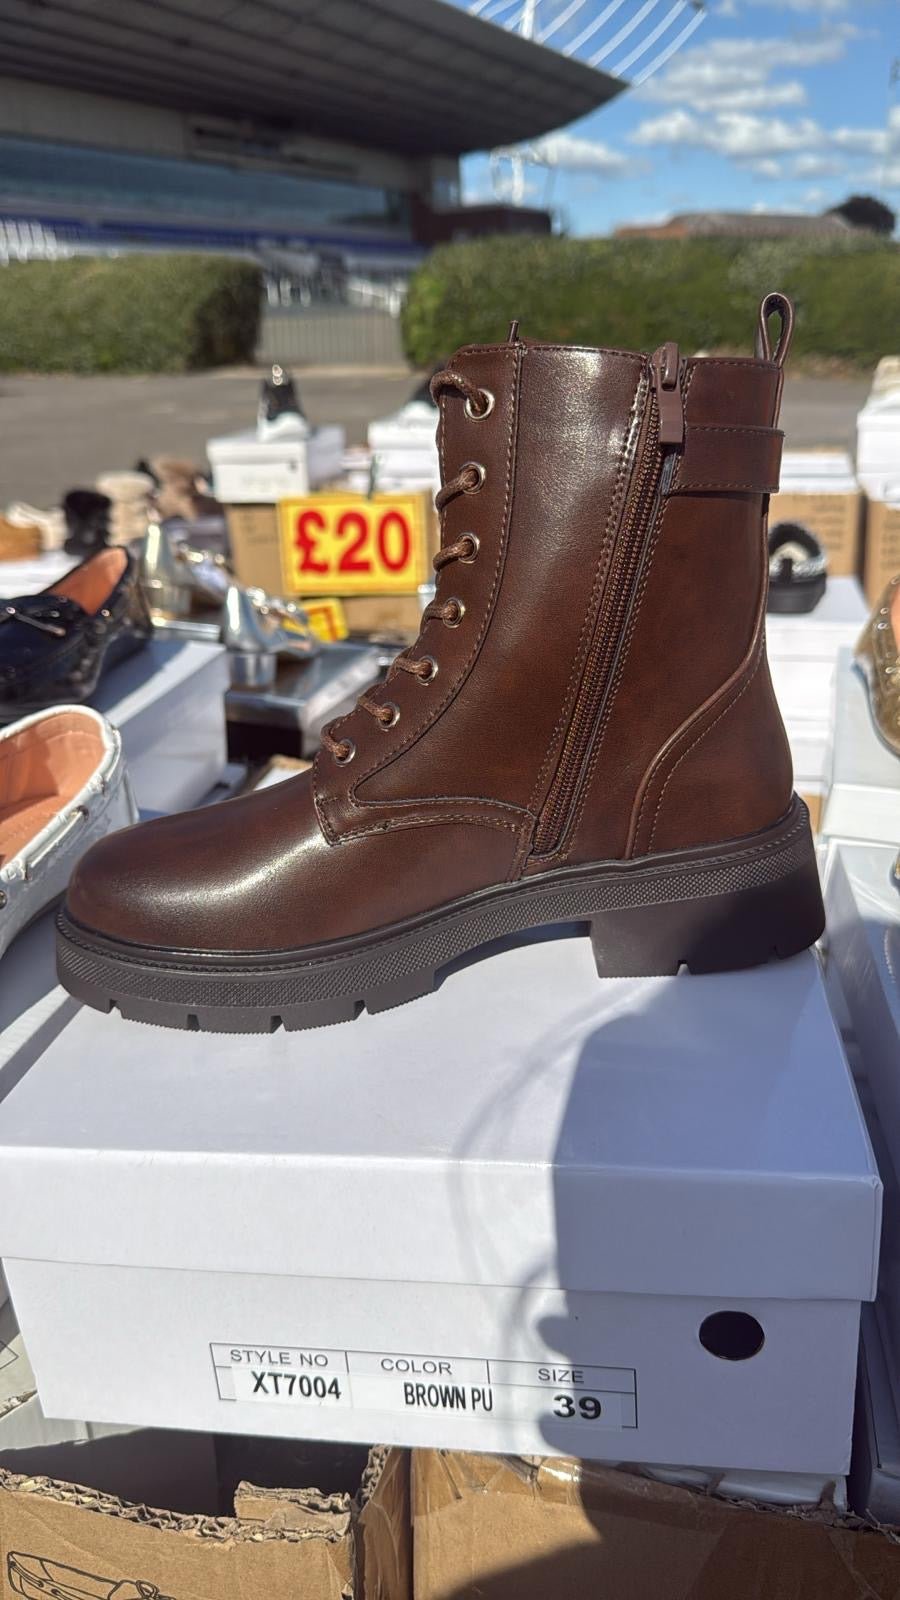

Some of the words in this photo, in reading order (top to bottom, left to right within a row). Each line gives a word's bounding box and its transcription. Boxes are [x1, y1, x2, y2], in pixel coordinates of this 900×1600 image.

[295, 510, 411, 574] £20
[230, 1349, 290, 1366] STYLE
[300, 1353, 329, 1367] NO
[380, 1358, 452, 1376] COLOR
[252, 1371, 342, 1401] XT7004
[538, 1367, 585, 1384] SIZE
[403, 1382, 467, 1411] BROWN
[470, 1387, 493, 1412] PU
[553, 1394, 601, 1420] 39
